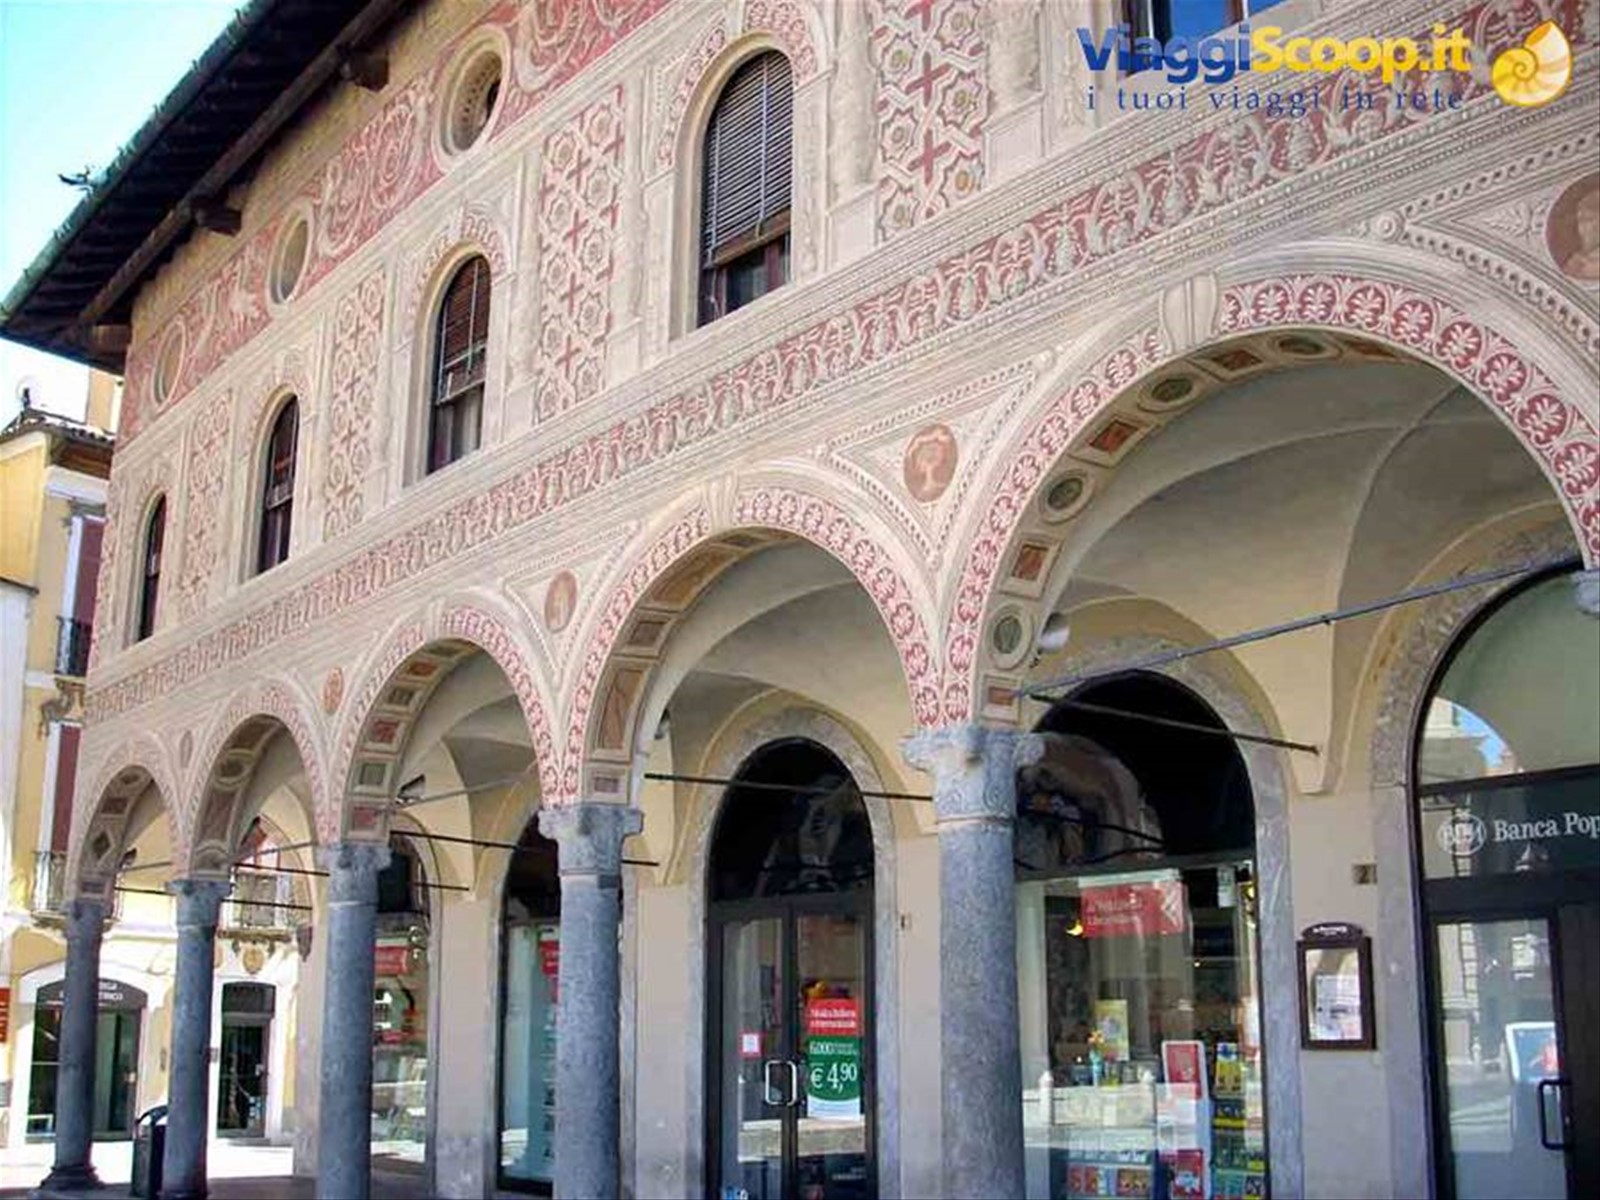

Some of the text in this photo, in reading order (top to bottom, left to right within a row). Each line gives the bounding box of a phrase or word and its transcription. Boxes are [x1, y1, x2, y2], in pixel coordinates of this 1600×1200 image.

[1494, 818, 1559, 842] Banca
[810, 1062, 858, 1093] € 4,90
